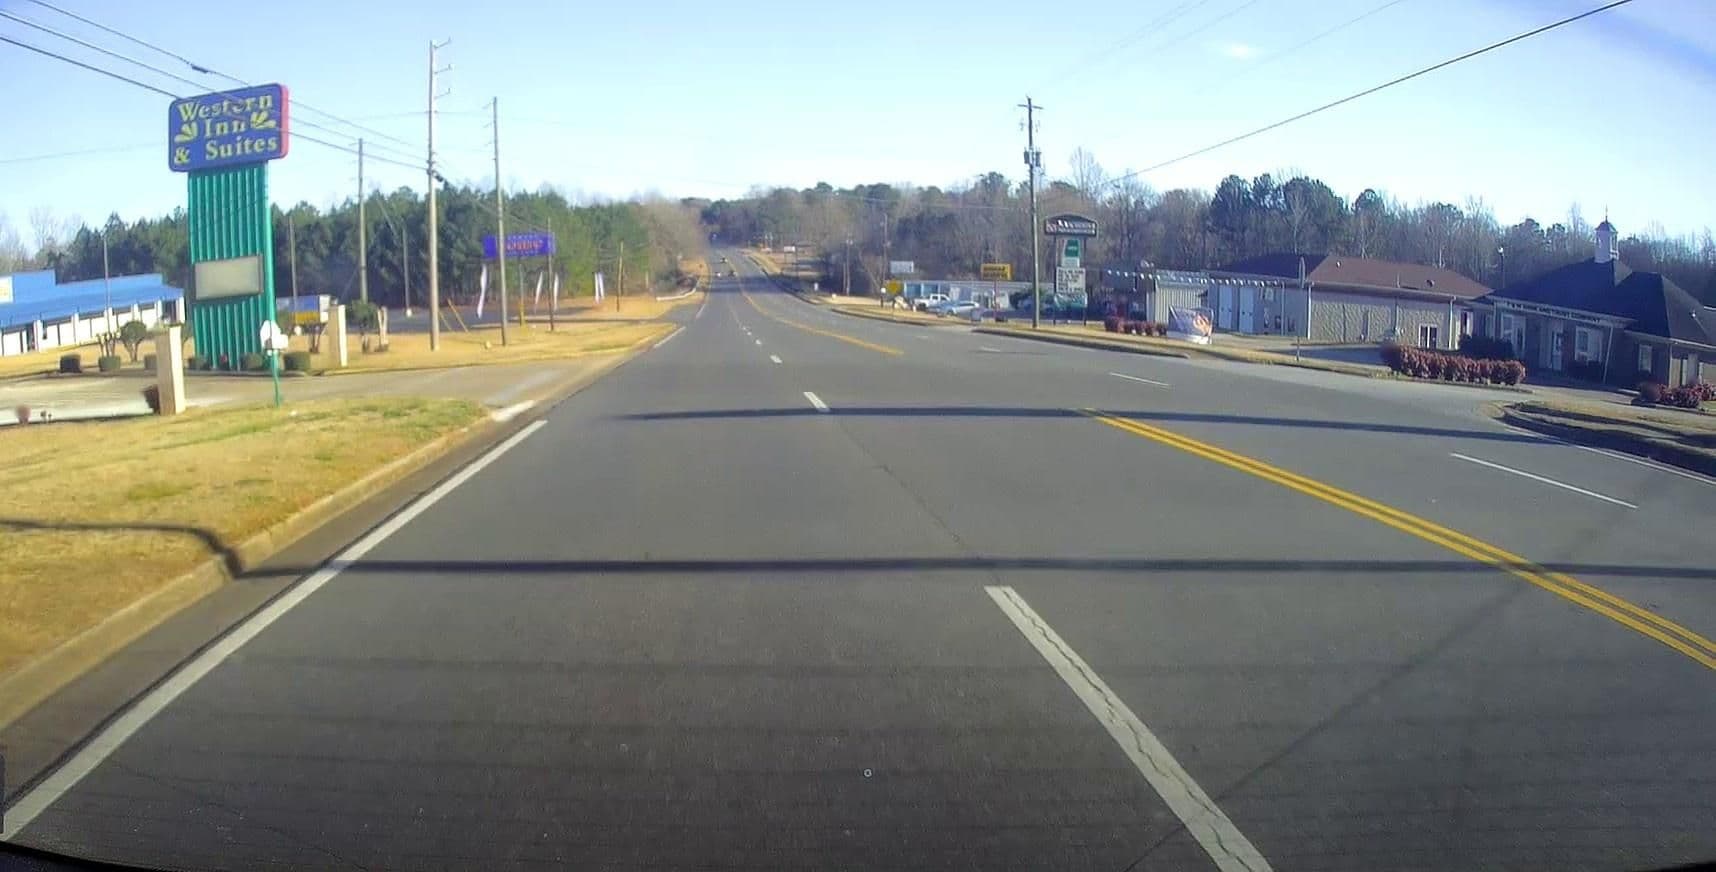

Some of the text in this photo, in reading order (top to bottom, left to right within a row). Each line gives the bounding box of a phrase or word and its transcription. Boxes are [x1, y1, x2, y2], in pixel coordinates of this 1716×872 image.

[178, 95, 272, 122] Western
[205, 118, 245, 138] Inn
[174, 135, 277, 165] & Suites
